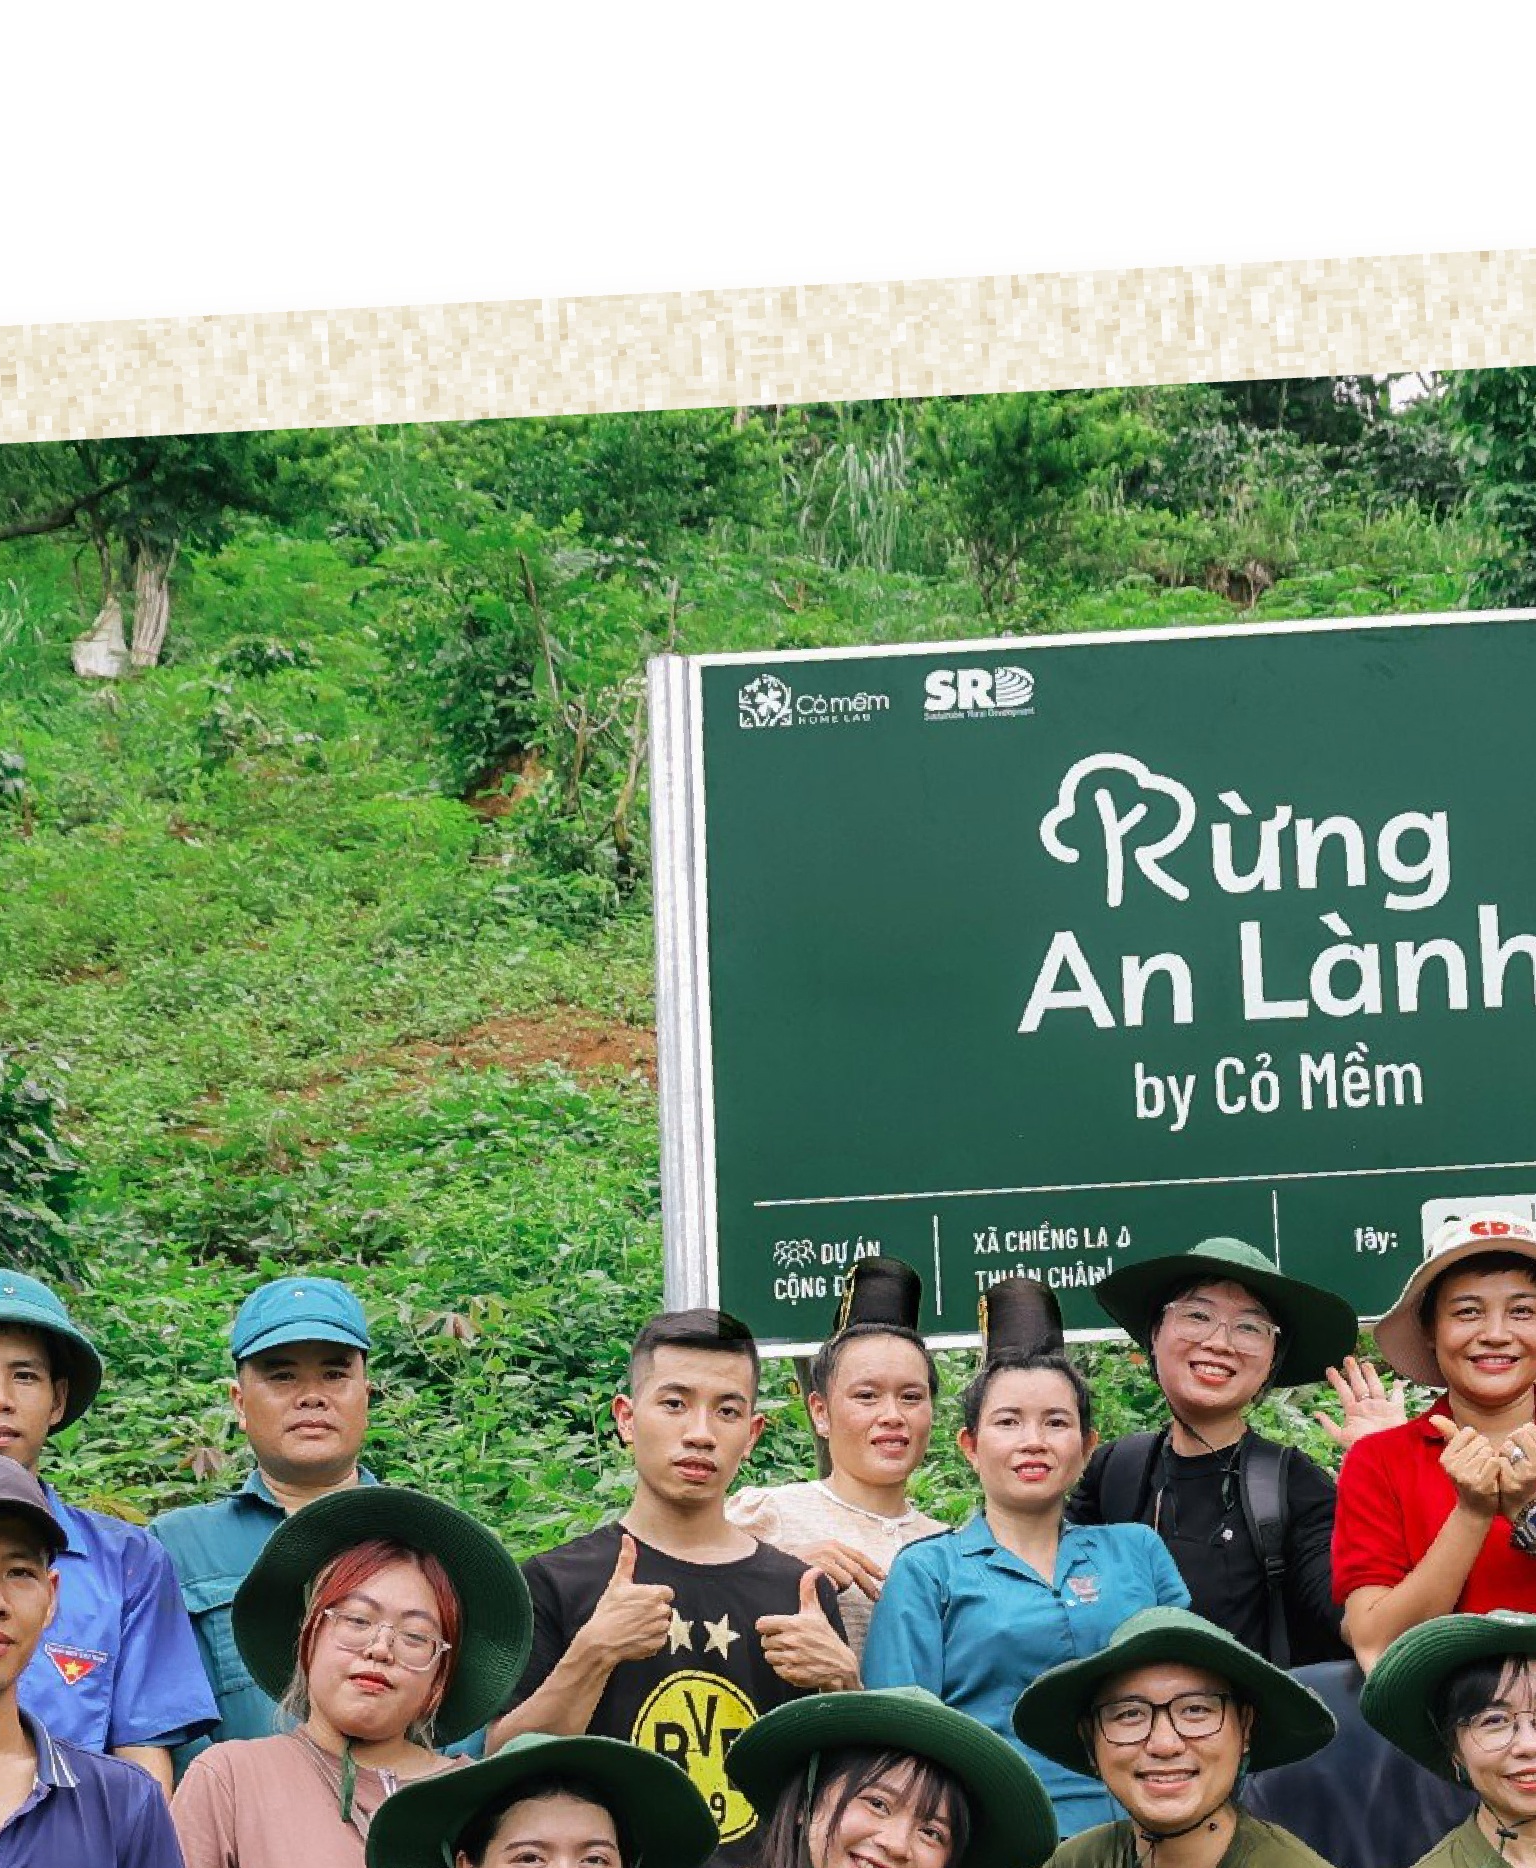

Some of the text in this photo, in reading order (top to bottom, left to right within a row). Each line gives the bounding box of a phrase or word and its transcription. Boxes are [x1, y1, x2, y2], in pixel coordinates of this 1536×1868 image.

[1039, 751, 1451, 912] Rừng
[1017, 930, 1194, 1034] An
[1133, 1042, 1424, 1132] by Cỏ Mềm
[820, 1242, 849, 1266] DỰ
[973, 1226, 1000, 1254] XÃ
[1005, 1220, 1078, 1252] CHIỀNG
[774, 1272, 826, 1306] CỘNG
